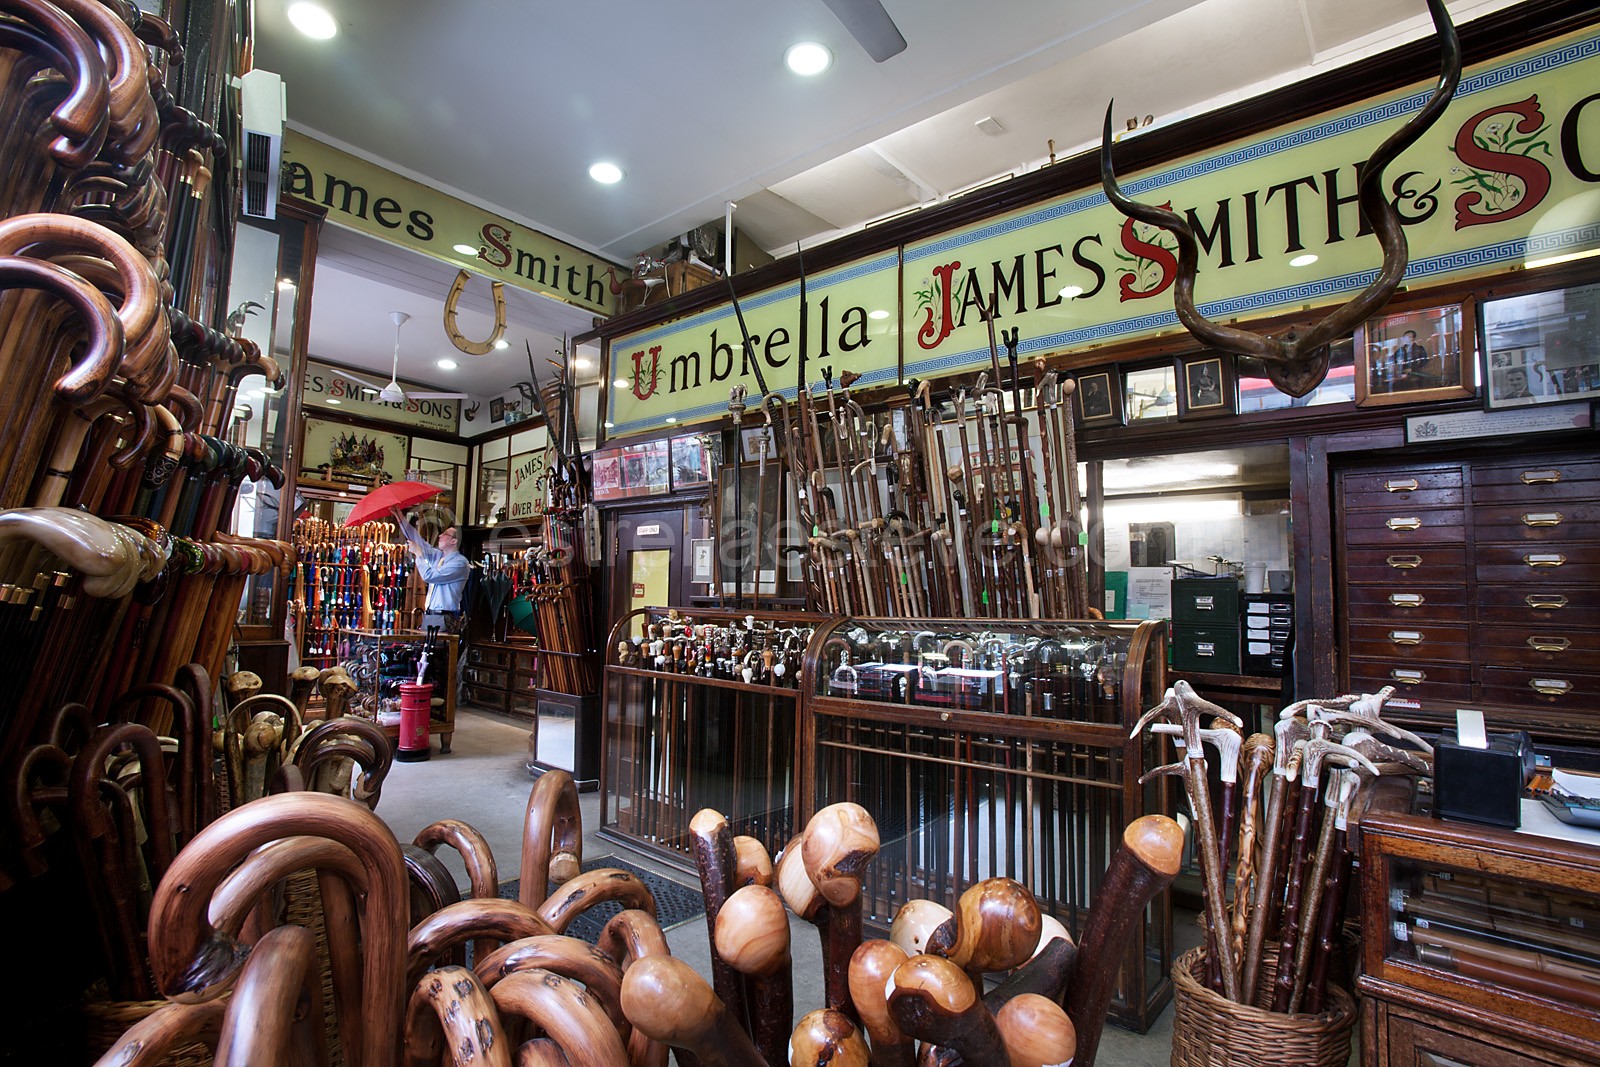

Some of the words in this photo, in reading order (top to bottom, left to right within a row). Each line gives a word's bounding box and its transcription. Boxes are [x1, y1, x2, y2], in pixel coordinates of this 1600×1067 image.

[284, 150, 434, 242] ames
[477, 222, 604, 307] Smith
[917, 233, 1106, 350] JAMES
[1119, 160, 1375, 303] SMITH
[1390, 170, 1442, 226] &
[330, 378, 389, 407] SMIT
[406, 398, 452, 420] SONS
[513, 455, 543, 490] JAMES
[512, 501, 532, 517] OVER
